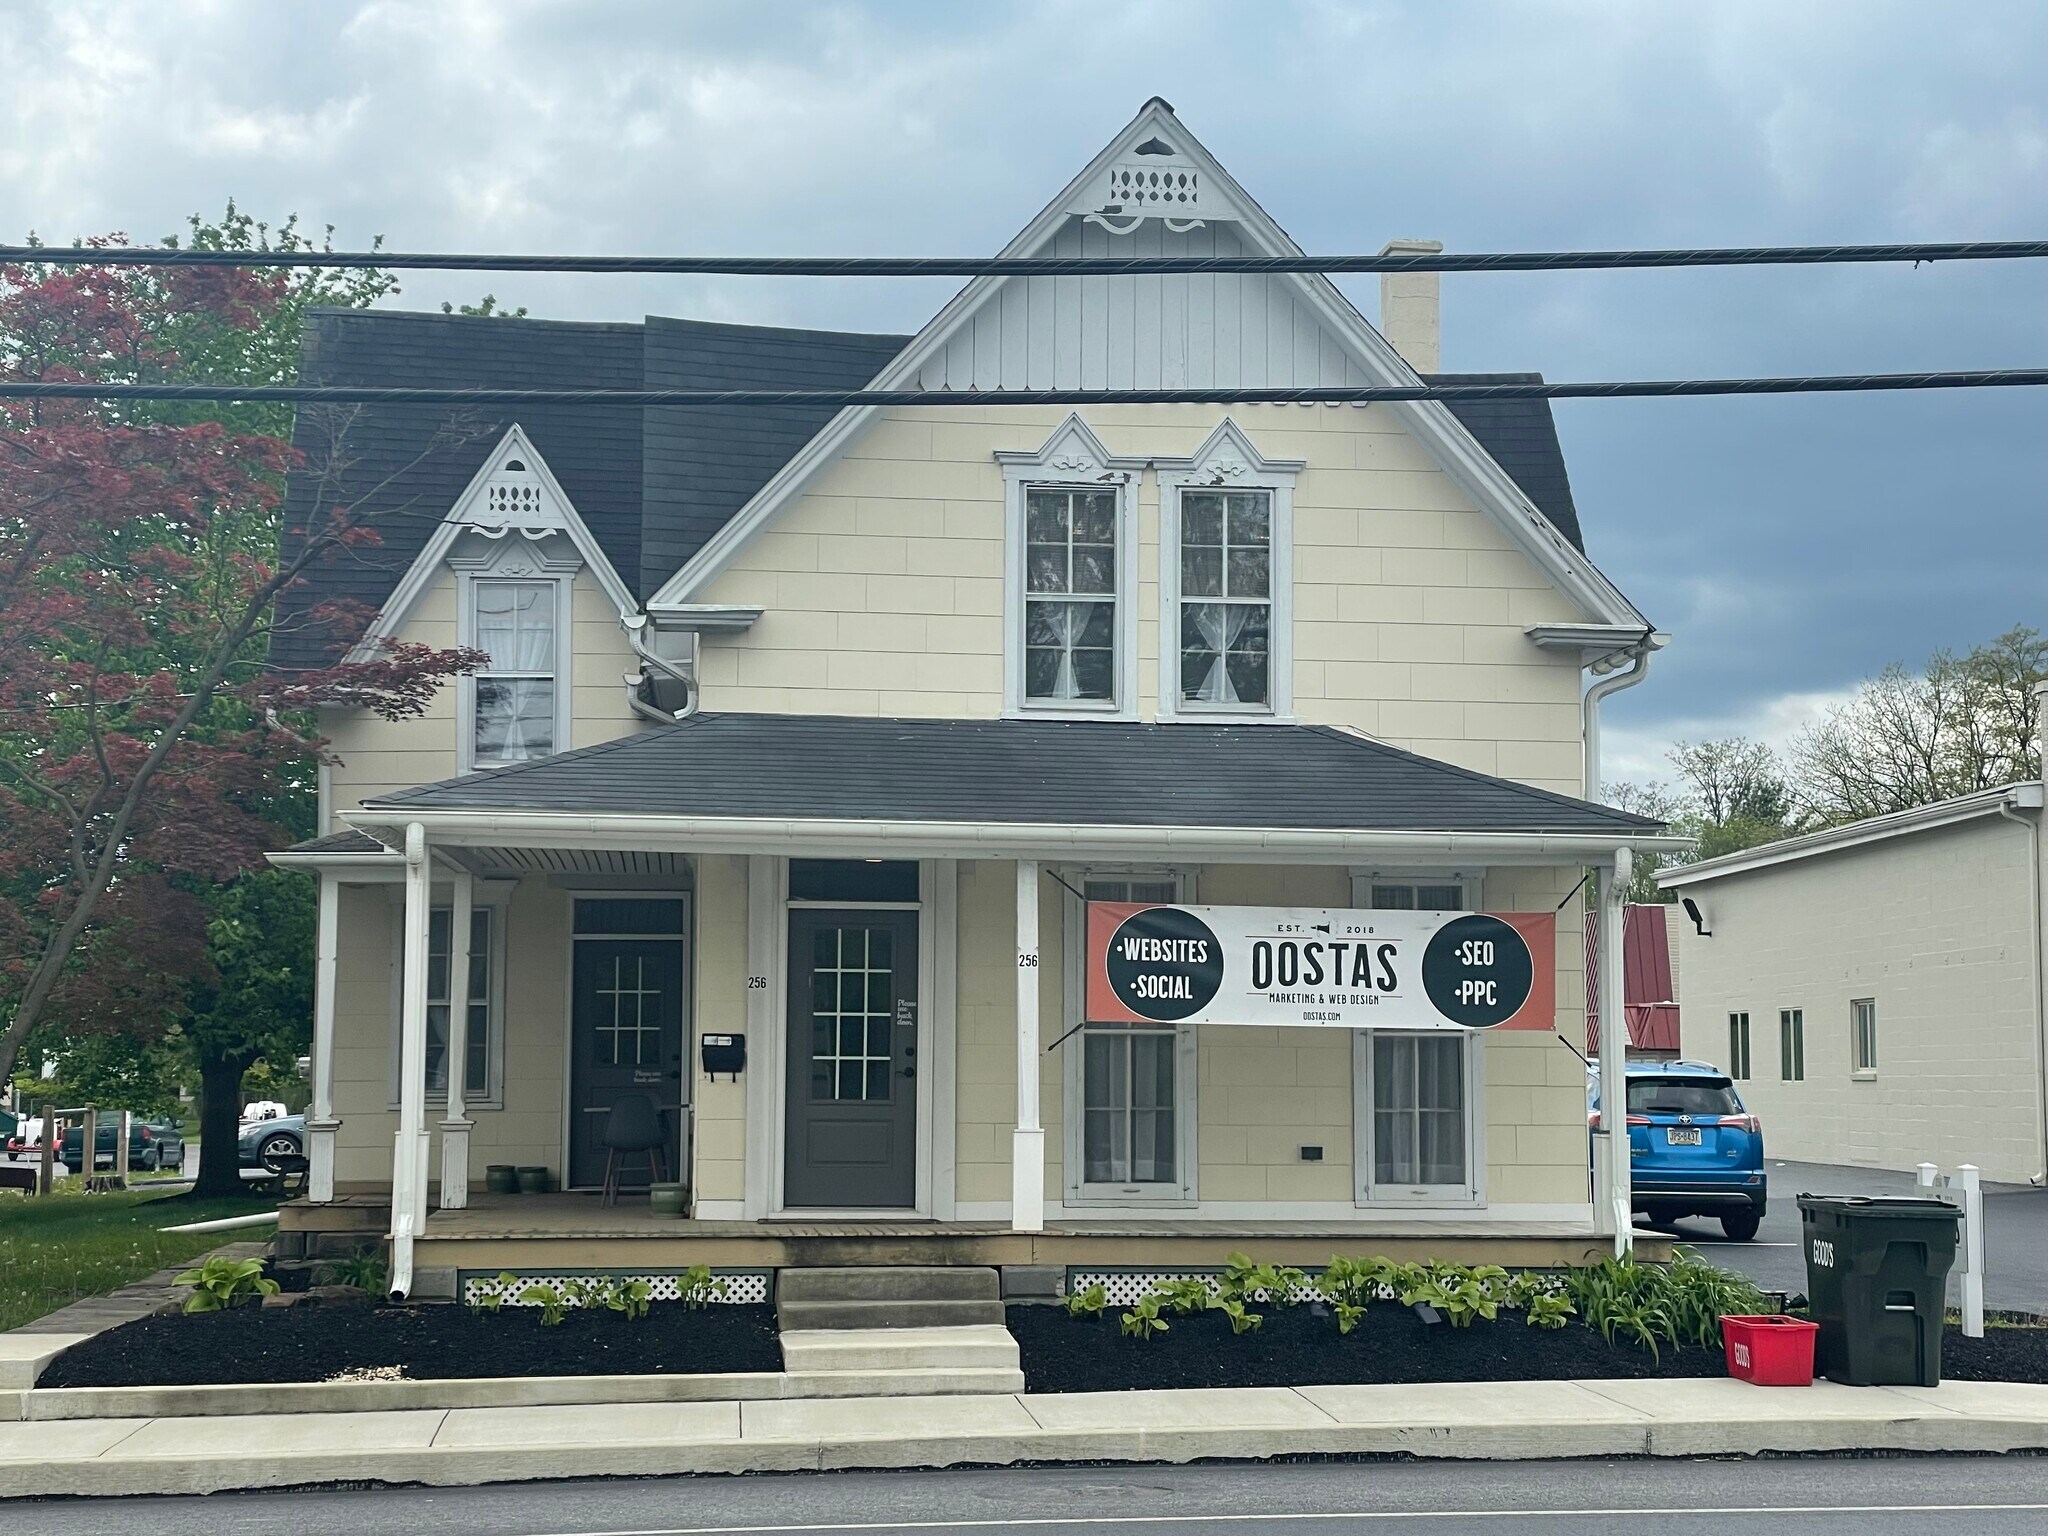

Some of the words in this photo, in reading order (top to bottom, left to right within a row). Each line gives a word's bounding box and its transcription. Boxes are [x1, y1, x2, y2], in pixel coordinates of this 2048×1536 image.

[1278, 924, 1305, 932] EST.
[1346, 926, 1374, 934] 2018
[1123, 938, 1208, 963] WEBSITES
[1461, 940, 1494, 966] SEO
[1019, 954, 1038, 967] 256
[1252, 941, 1398, 992] OOSTAS
[748, 976, 767, 989] 256
[1136, 974, 1194, 999] SOCIAL
[1269, 993, 1316, 1004] MARKETING
[1319, 995, 1325, 1004] &
[1328, 995, 1347, 1005] WEB
[1350, 996, 1379, 1005] DESIGN
[1462, 980, 1497, 1006] PPC
[897, 999, 917, 1007] Please
[1303, 1012, 1341, 1021] OOSTAS.COM
